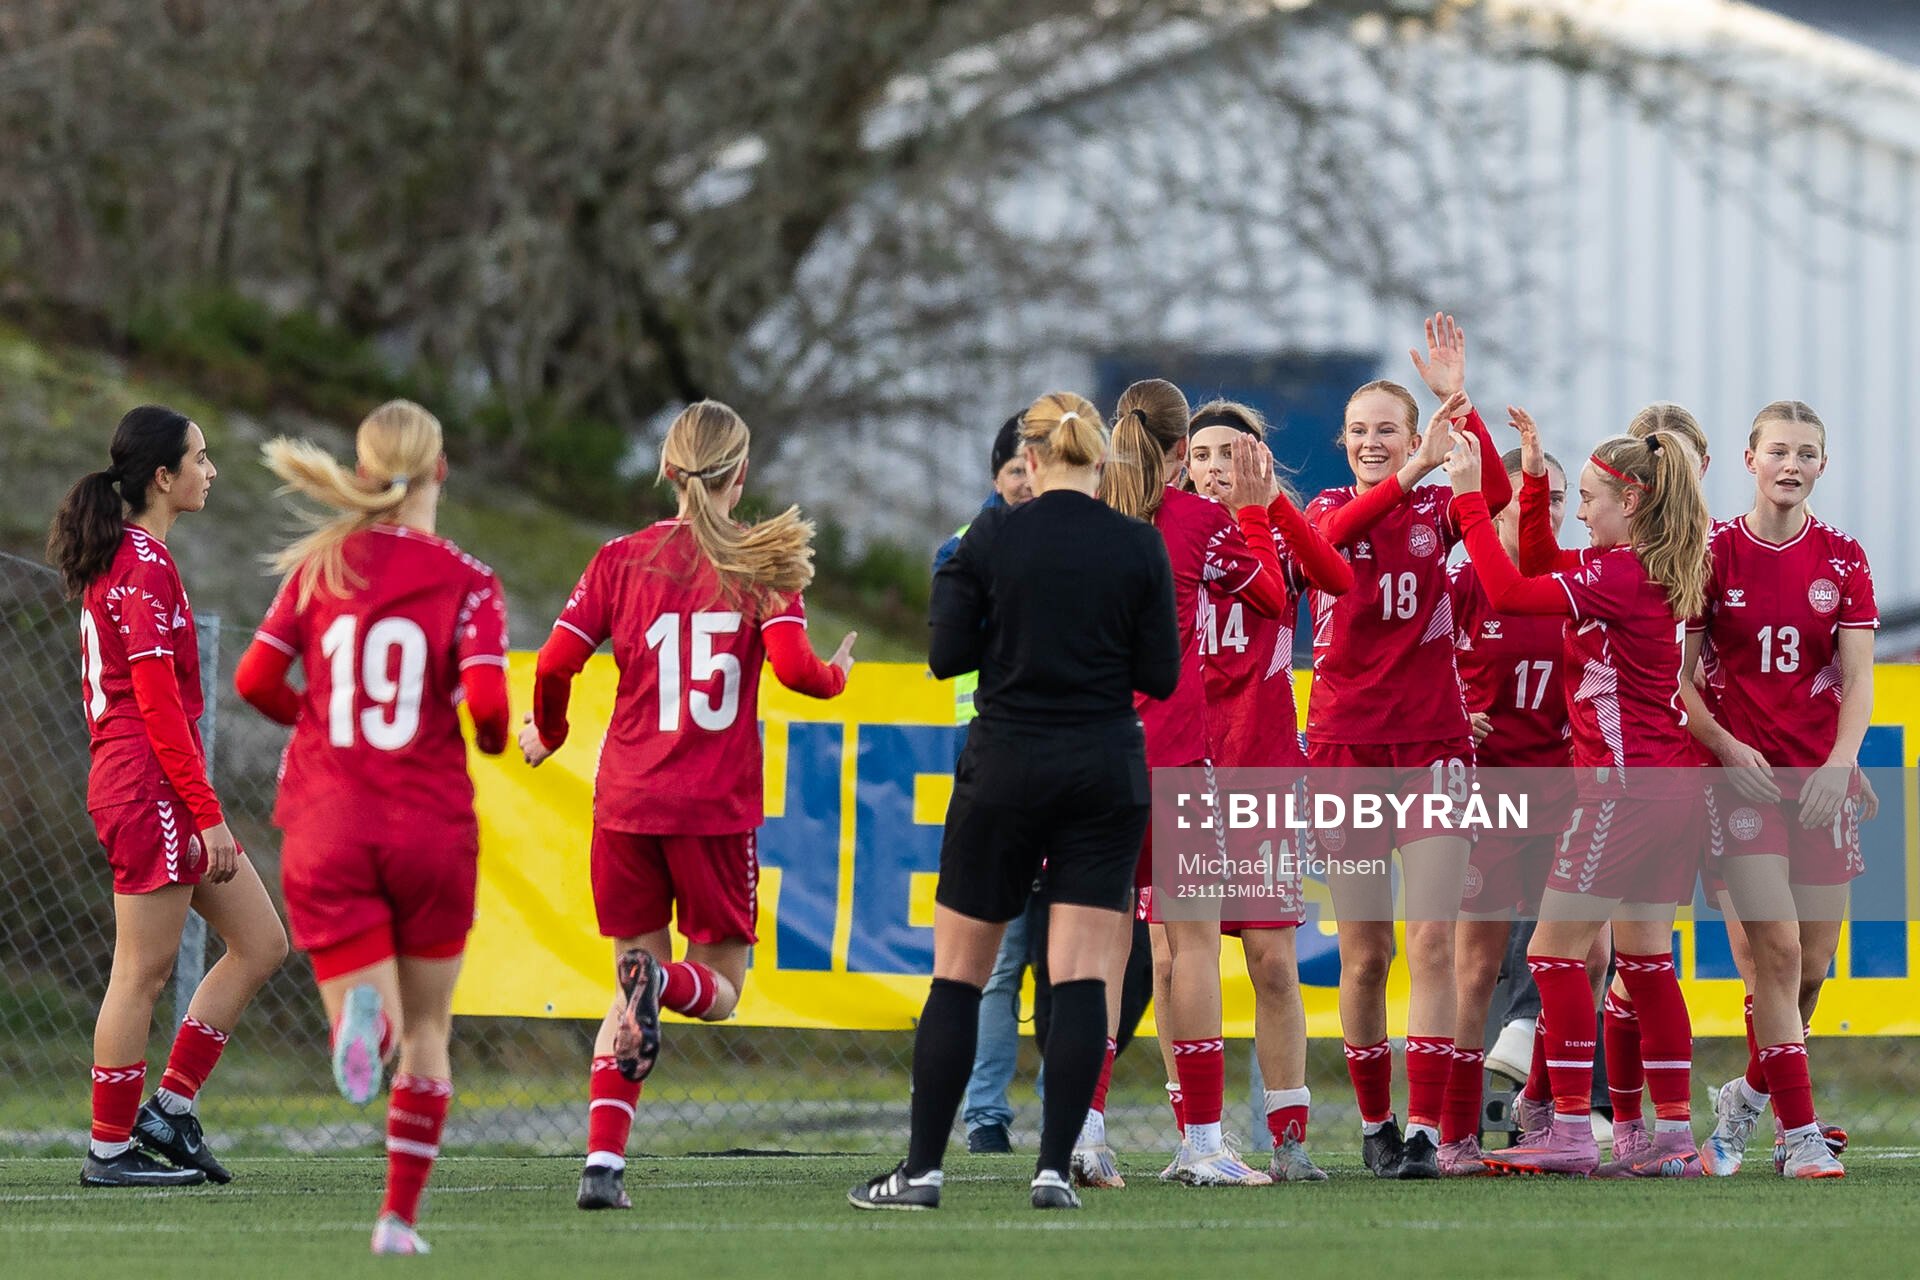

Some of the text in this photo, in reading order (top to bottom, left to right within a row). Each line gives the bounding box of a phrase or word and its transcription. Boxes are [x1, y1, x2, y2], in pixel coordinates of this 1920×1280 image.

[1378, 571, 1418, 620] 18
[1204, 602, 1250, 654] 14
[1757, 626, 1800, 673] 13
[321, 613, 427, 751] 19
[645, 611, 742, 732] 15
[1514, 660, 1554, 710] 17
[1430, 757, 1468, 803] 18
